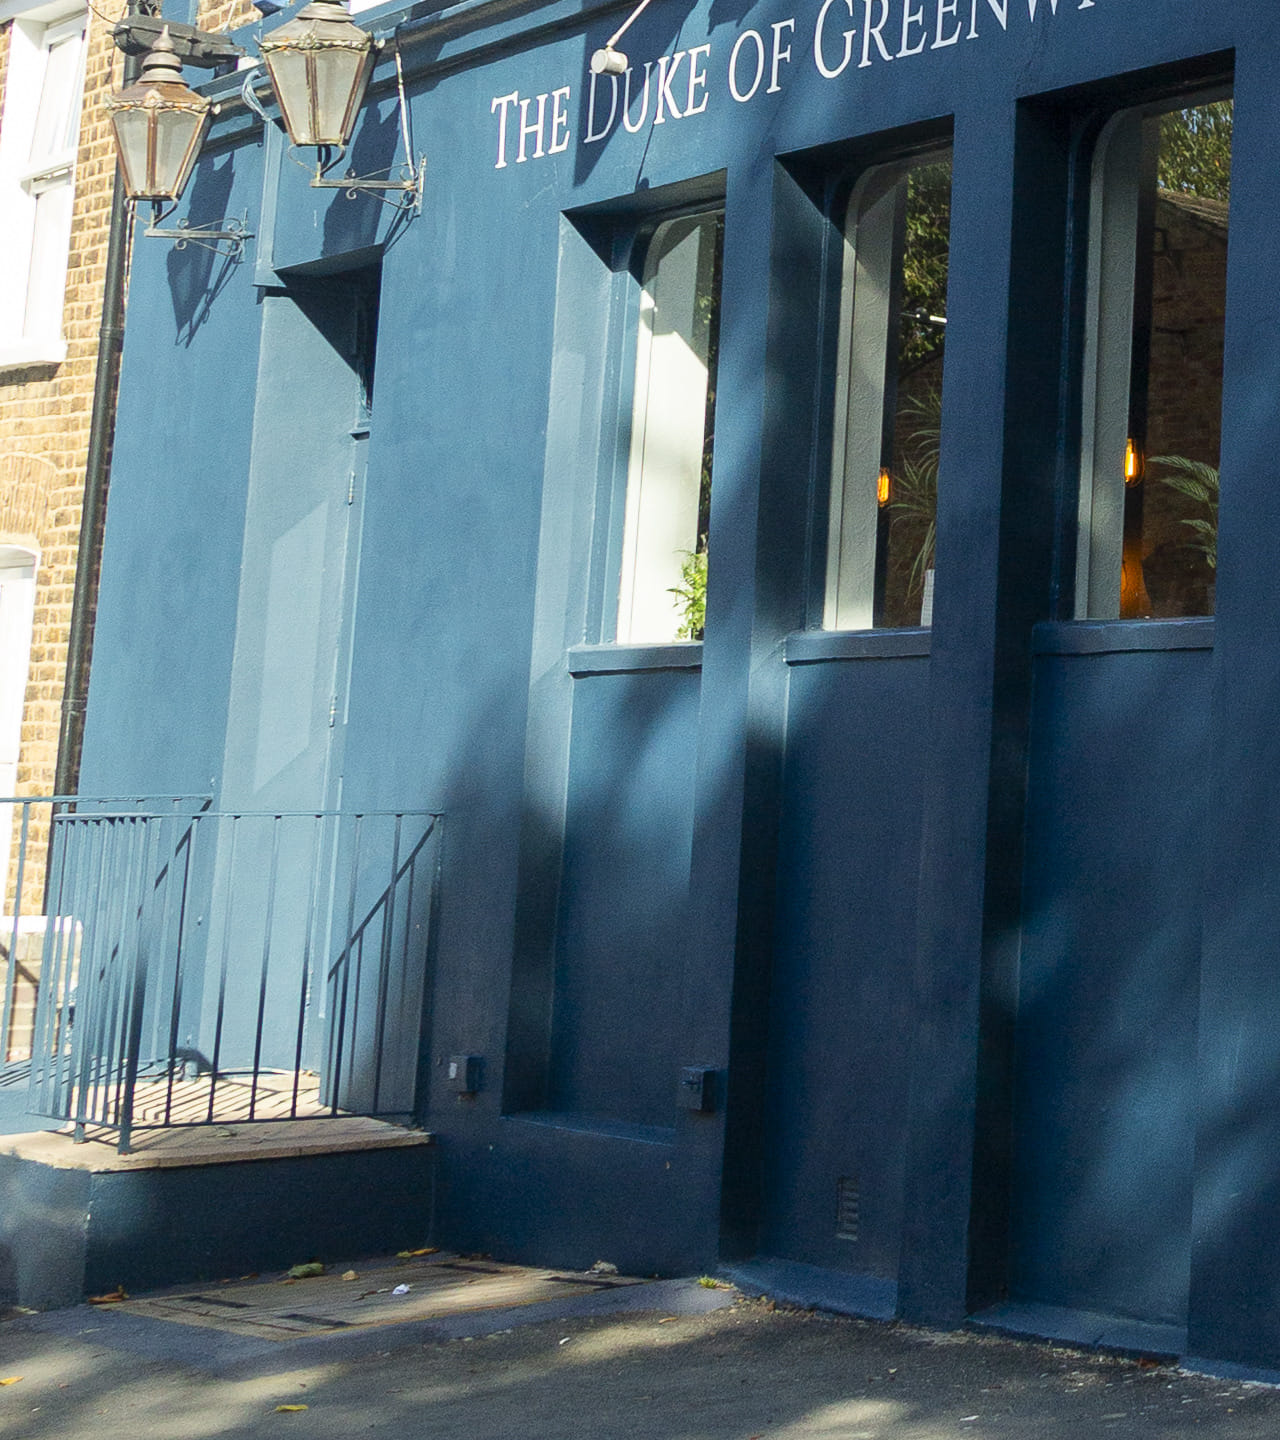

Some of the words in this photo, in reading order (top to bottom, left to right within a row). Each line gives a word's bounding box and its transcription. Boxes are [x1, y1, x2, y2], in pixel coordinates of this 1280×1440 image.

[491, 86, 571, 169] THE
[584, 44, 710, 145] DUKE
[727, 18, 795, 104] OF
